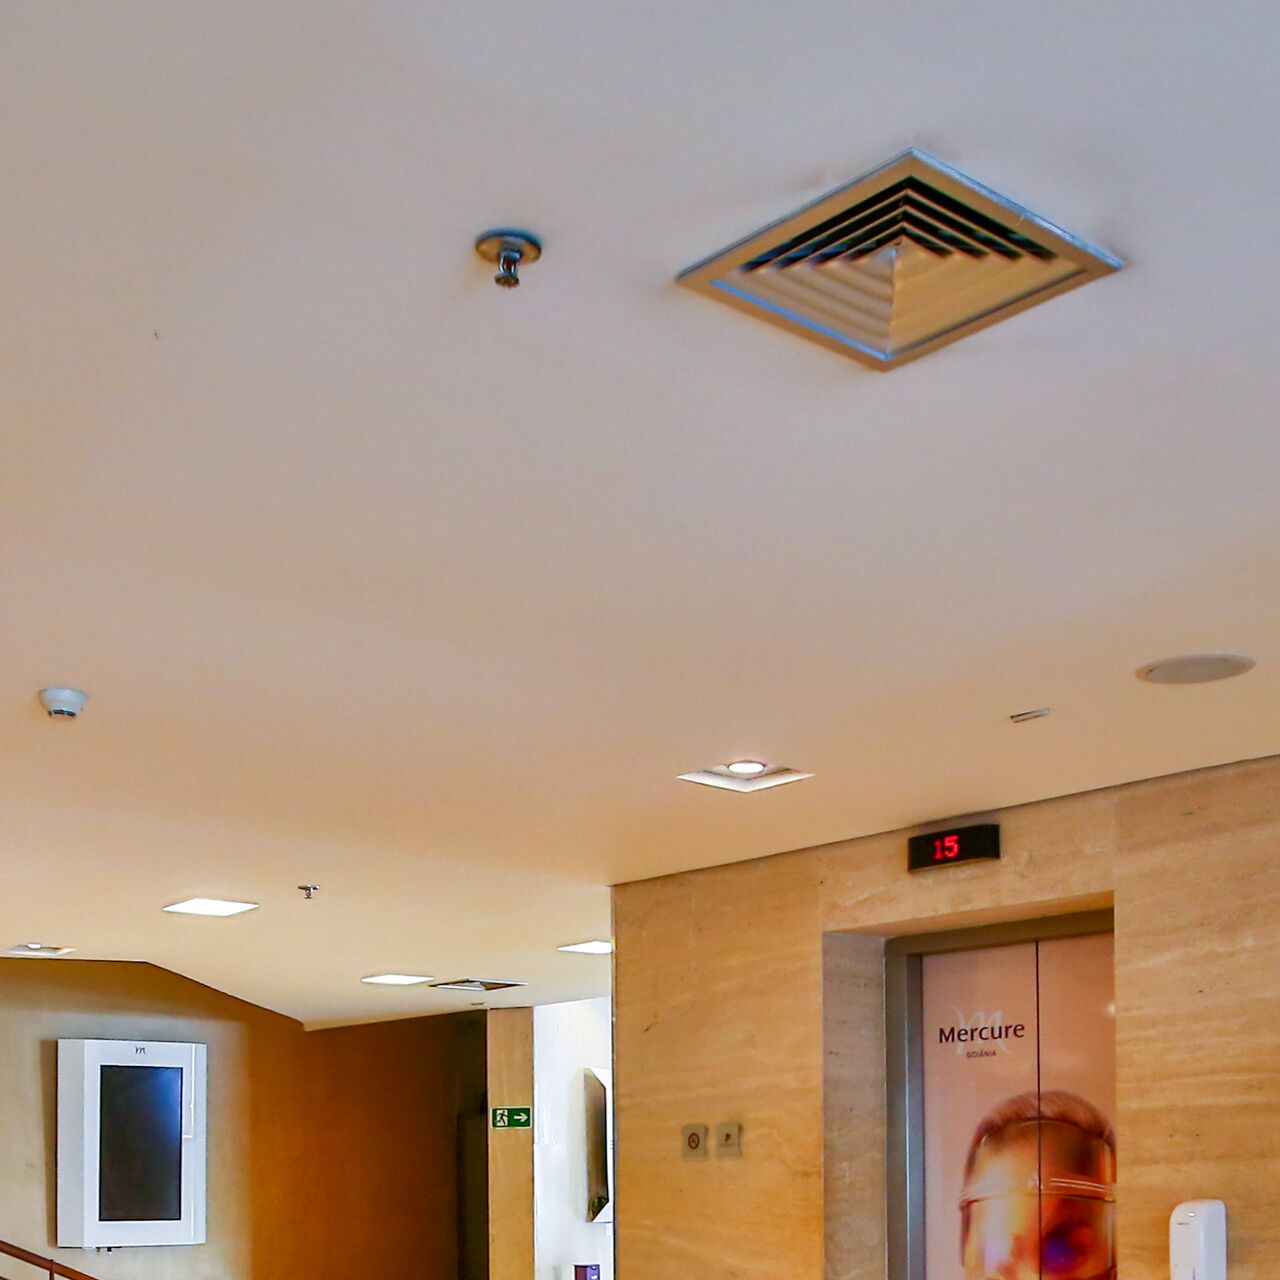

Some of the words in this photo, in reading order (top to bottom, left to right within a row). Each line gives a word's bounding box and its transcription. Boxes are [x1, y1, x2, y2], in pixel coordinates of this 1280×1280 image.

[934, 834, 960, 860] 15
[938, 1023, 1026, 1044] Mercure
[966, 1049, 997, 1059] GOIÂNIA
